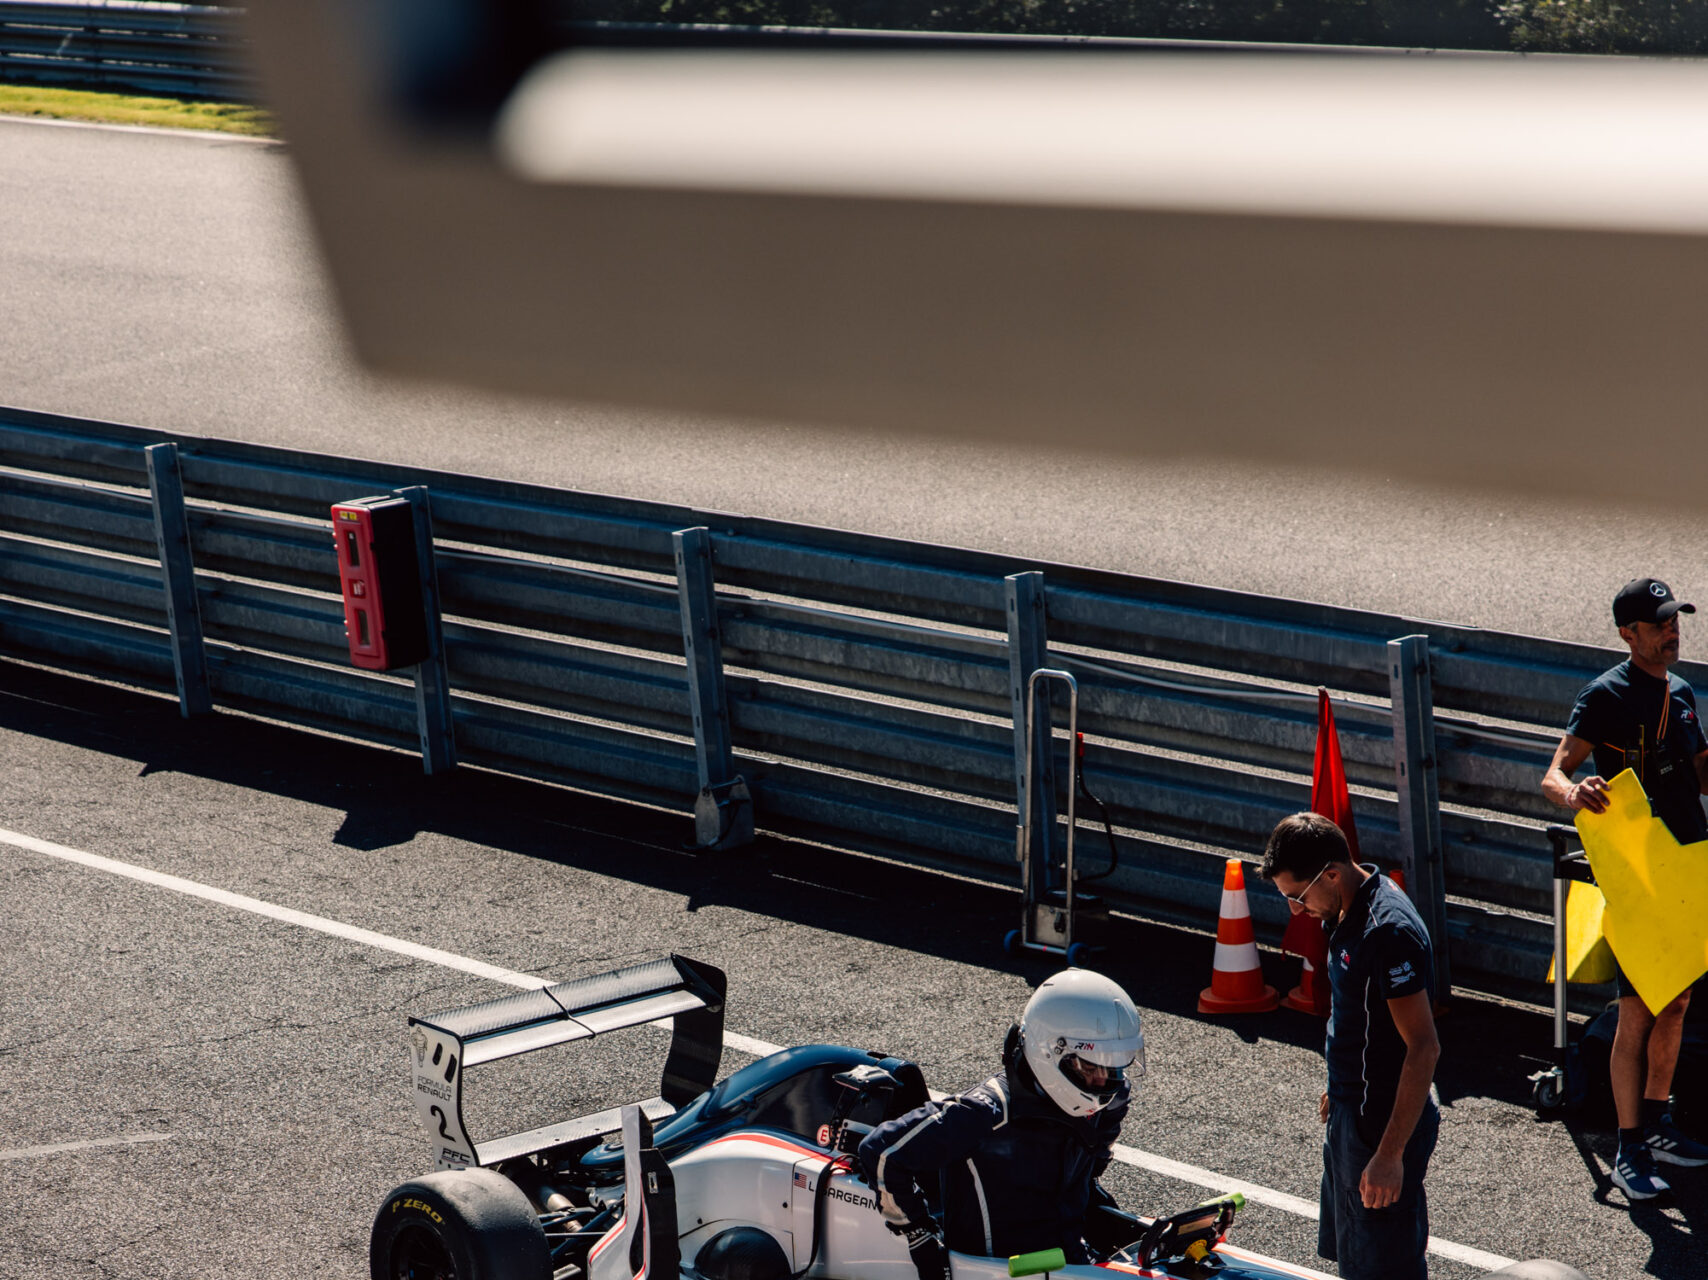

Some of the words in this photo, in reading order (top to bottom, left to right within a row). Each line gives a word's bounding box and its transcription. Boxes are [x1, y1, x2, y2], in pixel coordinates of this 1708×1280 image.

[417, 1083, 452, 1102] RENAULT
[418, 1075, 452, 1093] FORMULA
[430, 1104, 456, 1142] 2
[442, 1148, 471, 1163] PFC
[824, 1186, 877, 1210] ARGEAN
[393, 1200, 400, 1213] P
[403, 1198, 444, 1224] ZERO
